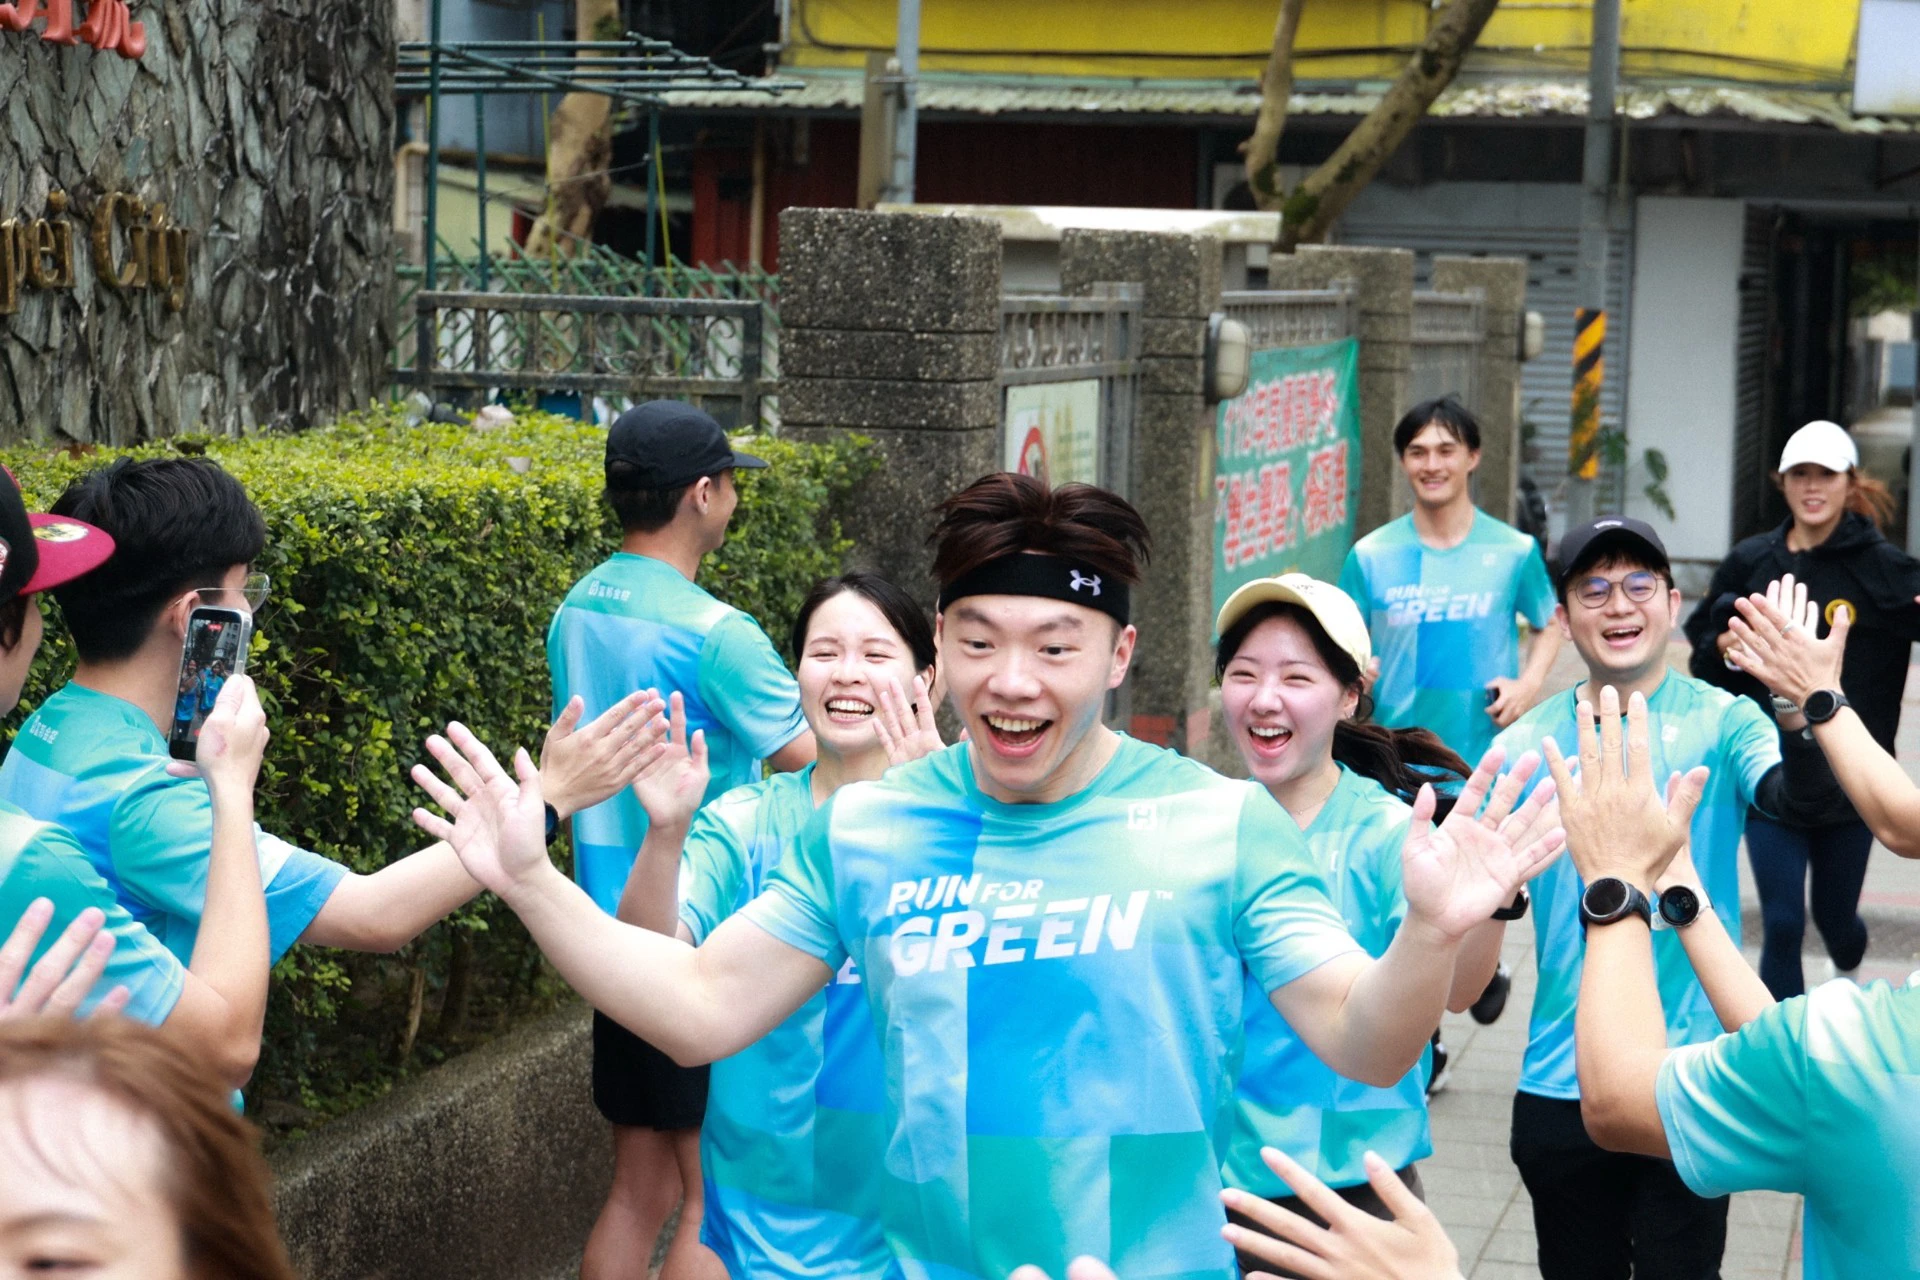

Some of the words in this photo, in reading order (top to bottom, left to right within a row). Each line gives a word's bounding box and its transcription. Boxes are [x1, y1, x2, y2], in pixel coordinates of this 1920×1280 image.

[92, 191, 190, 313] City
[1386, 592, 1493, 627] GREEN
[886, 873, 984, 916] RUN
[980, 878, 1044, 904] FOR
[889, 890, 1150, 977] GREEN
